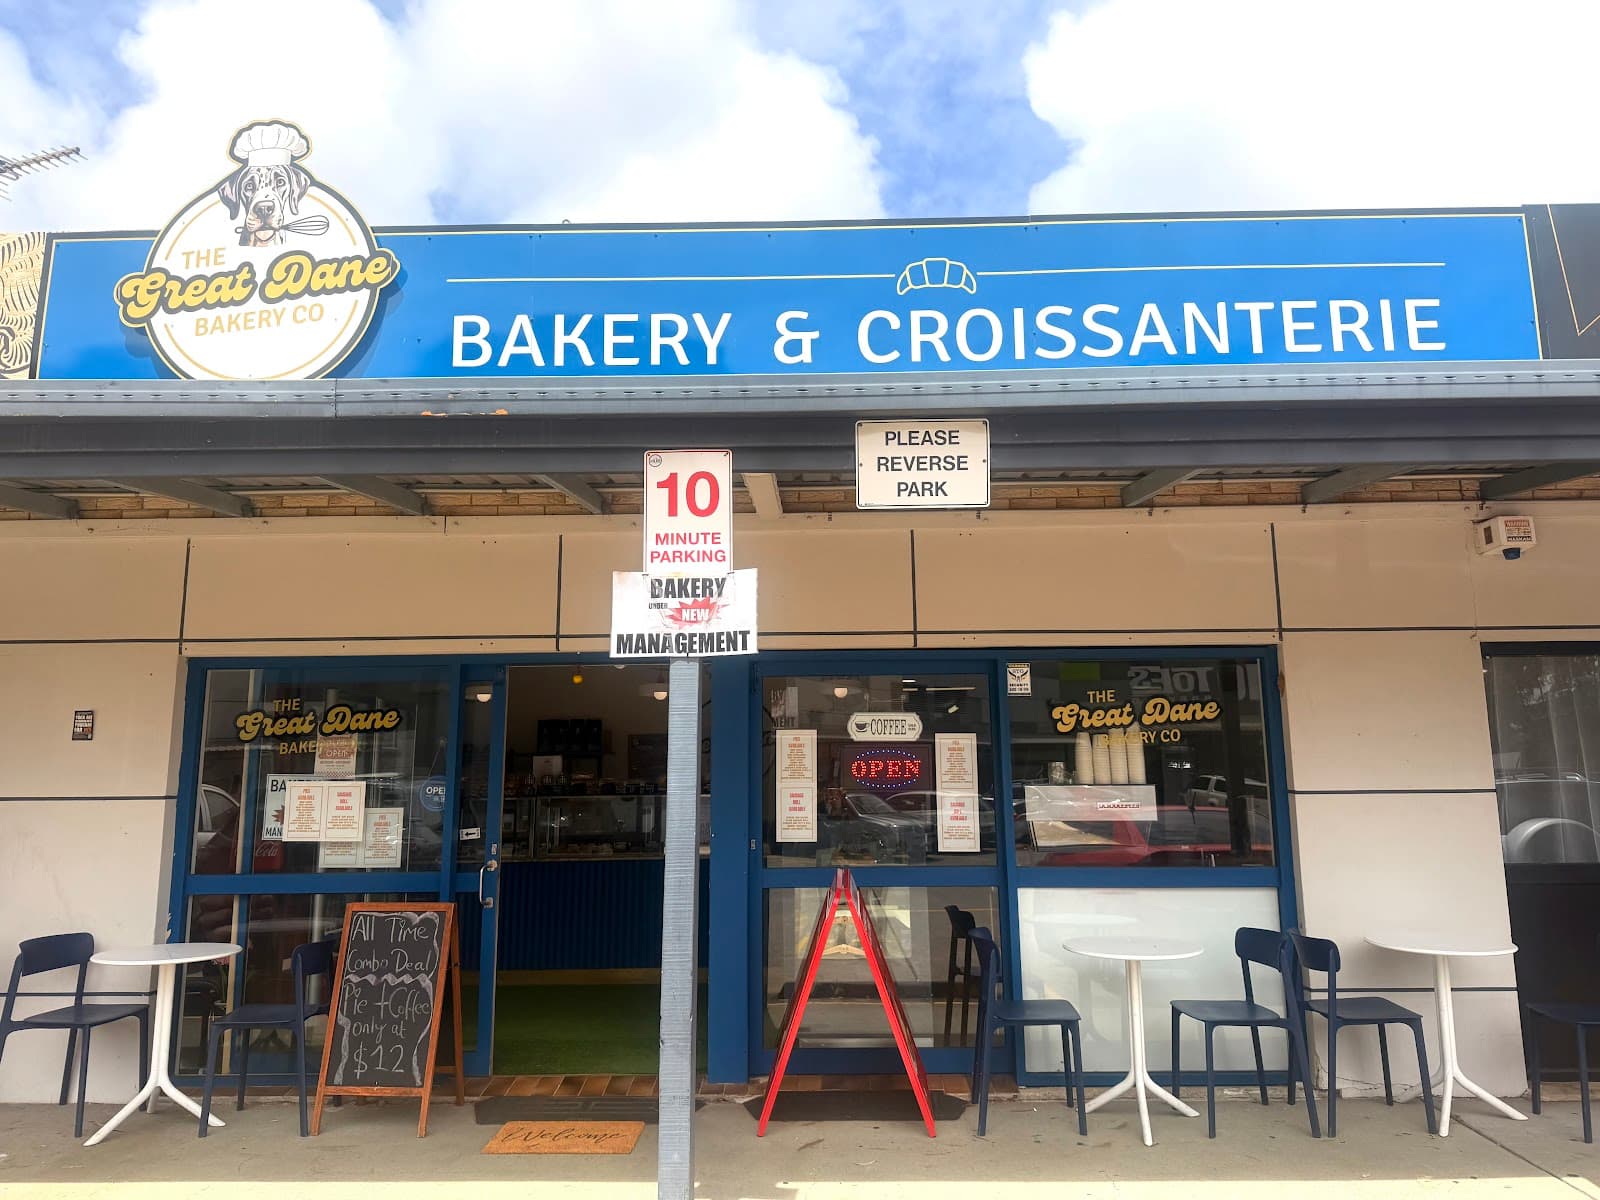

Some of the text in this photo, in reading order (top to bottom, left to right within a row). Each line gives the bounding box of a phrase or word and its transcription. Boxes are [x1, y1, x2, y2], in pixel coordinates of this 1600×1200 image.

[182, 248, 226, 269] THE
[121, 254, 393, 320] Great Dane
[194, 303, 325, 336] BAKERY CO
[452, 298, 1446, 367] BAKERY & CROISSANTERIE
[885, 430, 961, 446] PLEASE
[876, 455, 969, 472] REVERSE
[656, 471, 720, 518] 10
[897, 481, 948, 497] PARK
[655, 532, 722, 546] MINUTE
[650, 549, 726, 563] PARKING
[651, 577, 727, 599] BAKERY
[648, 602, 668, 610] UNDER
[681, 608, 710, 621] NEW
[616, 630, 751, 654] MANAGEMENT
[273, 698, 300, 712] THE
[1087, 690, 1115, 703] THE
[236, 706, 400, 741] Great Dane
[1051, 697, 1220, 733] Great Dane
[870, 719, 906, 735] COFFEE
[1161, 728, 1181, 743] CO
[851, 760, 921, 778] OPEN
[426, 786, 446, 795] OPE
[352, 915, 429, 943] All Time
[347, 948, 432, 973] Combo Deal
[343, 983, 368, 1016] Pie
[391, 1021, 407, 1038] at
[353, 1041, 405, 1080] $12
